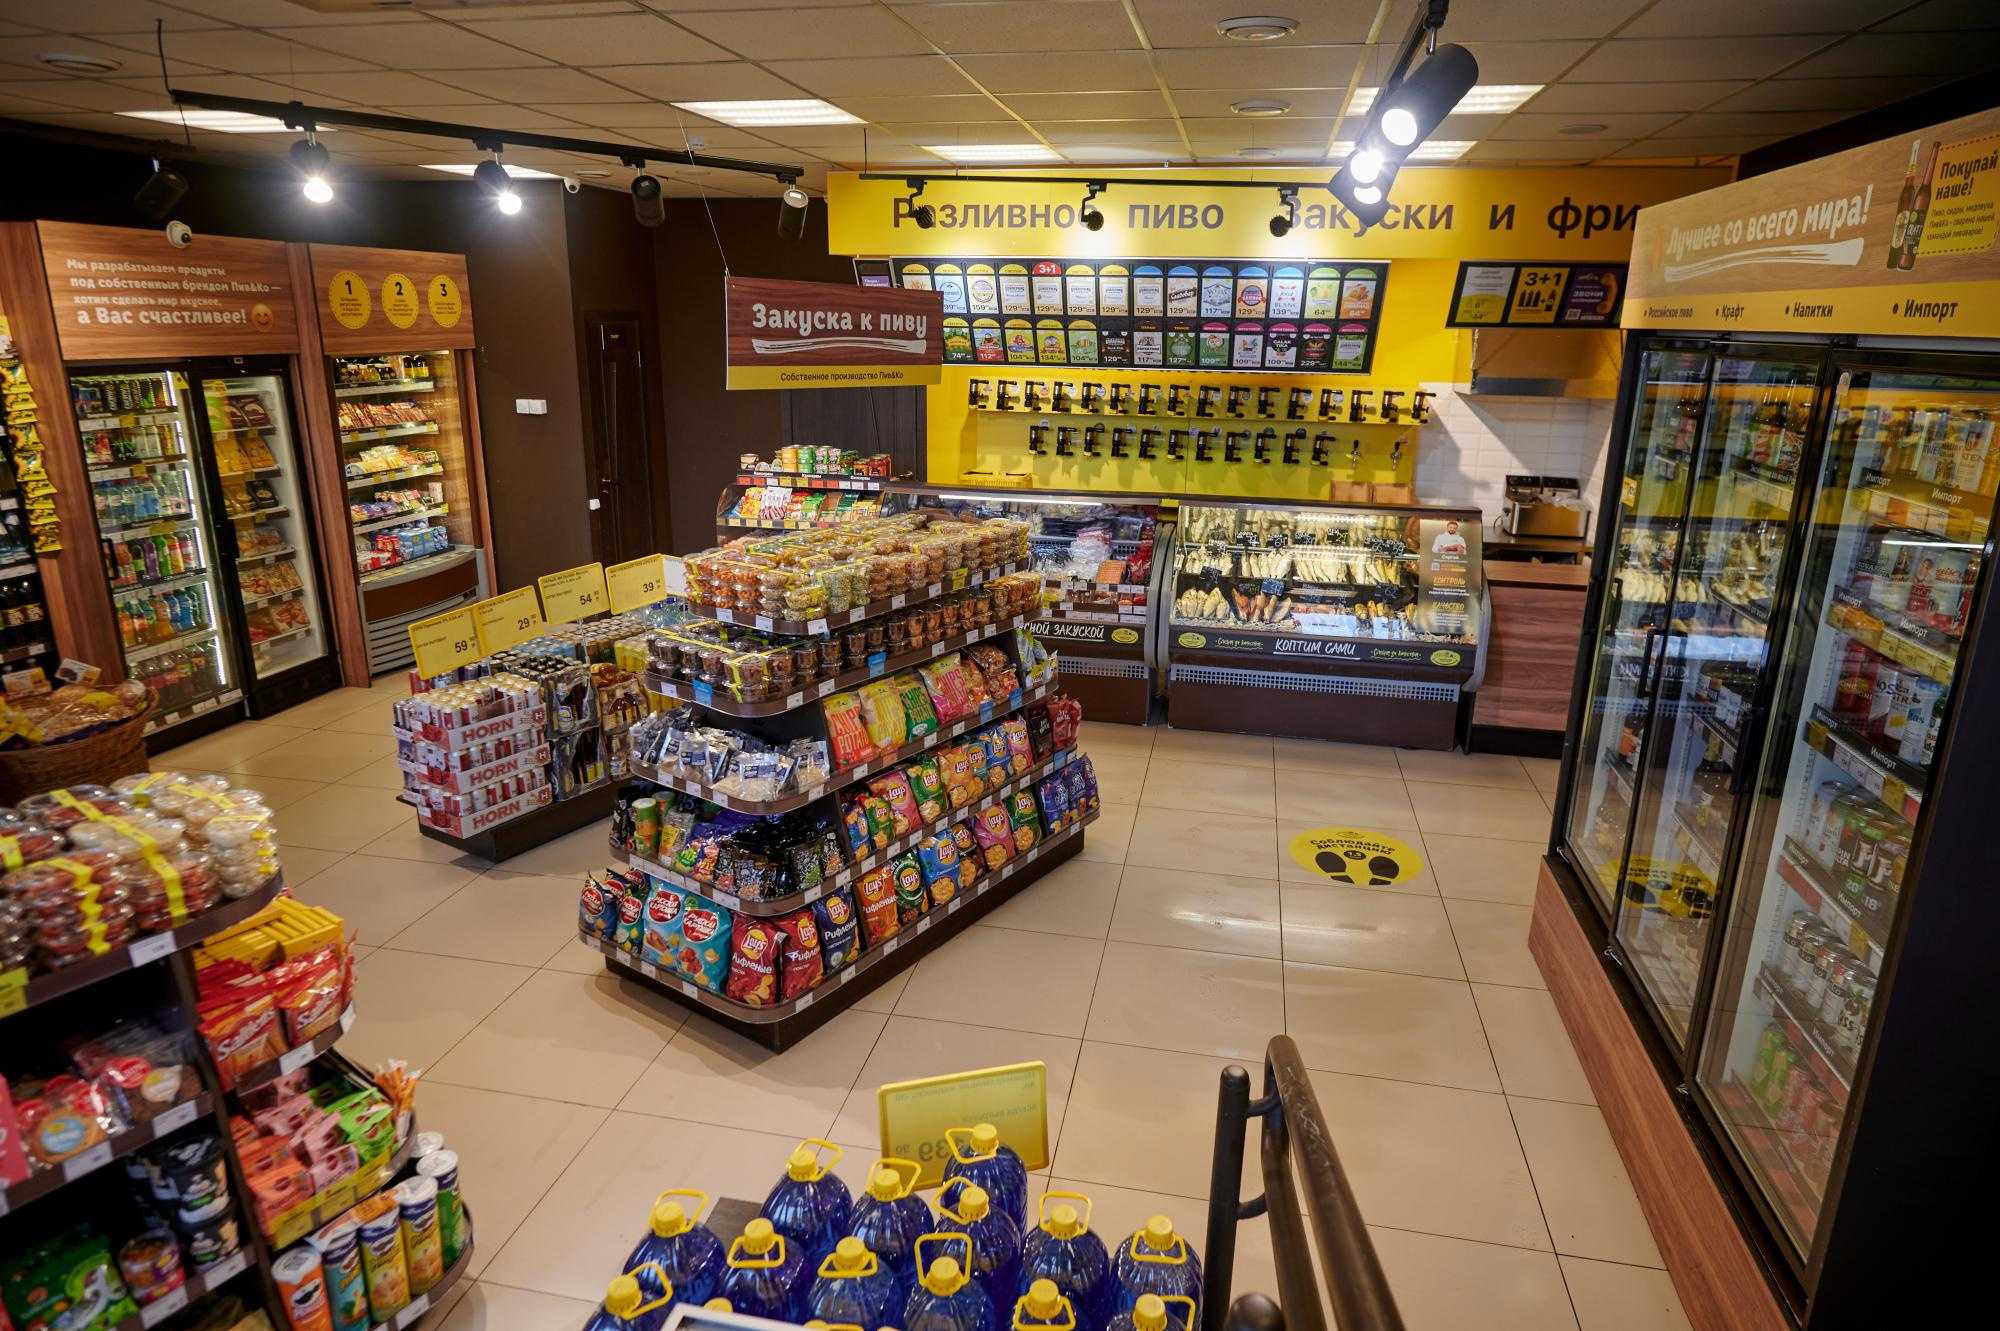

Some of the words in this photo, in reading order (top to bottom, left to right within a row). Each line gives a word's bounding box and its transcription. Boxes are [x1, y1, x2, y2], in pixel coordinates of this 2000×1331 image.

[1939, 149, 1998, 181] Покупай
[1935, 178, 1974, 201] наше!
[1128, 204, 1224, 229] пиво
[1490, 203, 1515, 231] и
[1667, 224, 1720, 262] Лучшее
[1724, 219, 1743, 246] со
[1746, 207, 1798, 241] всего
[1802, 184, 1873, 239] мира!
[66, 259, 88, 270] Мы
[90, 261, 176, 276] разрабатываем
[178, 266, 225, 277] продукты
[1039, 264, 1056, 273] 3+1
[70, 277, 95, 289] под
[98, 278, 180, 290] собственным
[182, 280, 229, 292] брендом
[231, 282, 269, 293] Пив&Ко
[1524, 272, 1563, 286] 3+1
[345, 280, 352, 295] 1
[395, 281, 403, 296] 2
[440, 283, 447, 297] 3
[74, 295, 108, 305] хотим
[112, 296, 154, 306] сделать
[77, 309, 90, 324] а
[95, 307, 134, 324] Вас
[139, 308, 246, 324] счастливее!
[1721, 303, 1745, 321] Крафт
[1792, 302, 1834, 318] Напитки
[1904, 299, 1958, 321] Импорт
[752, 303, 853, 337] Закуска
[860, 312, 873, 331] к
[880, 313, 927, 338] пиву
[780, 372, 829, 382] Собственное
[830, 371, 878, 383] производство
[879, 371, 904, 380] Пив&Ко
[1866, 472, 1891, 487] Импорт
[1932, 487, 1962, 505] Импорт
[643, 582, 654, 593] 39
[580, 593, 592, 605] 54
[1838, 591, 1862, 608] Импорт
[517, 617, 530, 630] 29
[1054, 624, 1105, 639] ЗАКУСКОЙ
[1900, 617, 1928, 637] Импорт
[454, 640, 468, 653] 59
[1275, 638, 1320, 653] КОПТИМ
[1325, 641, 1356, 656] САМИ
[1816, 709, 1838, 729] Импорт
[461, 717, 514, 744] HORN
[1871, 747, 1897, 769] Импорт
[469, 758, 519, 787] HORN
[472, 800, 521, 830] HORN
[1310, 838, 1396, 852] Соблюдайте
[1837, 891, 1863, 918] Импорт
